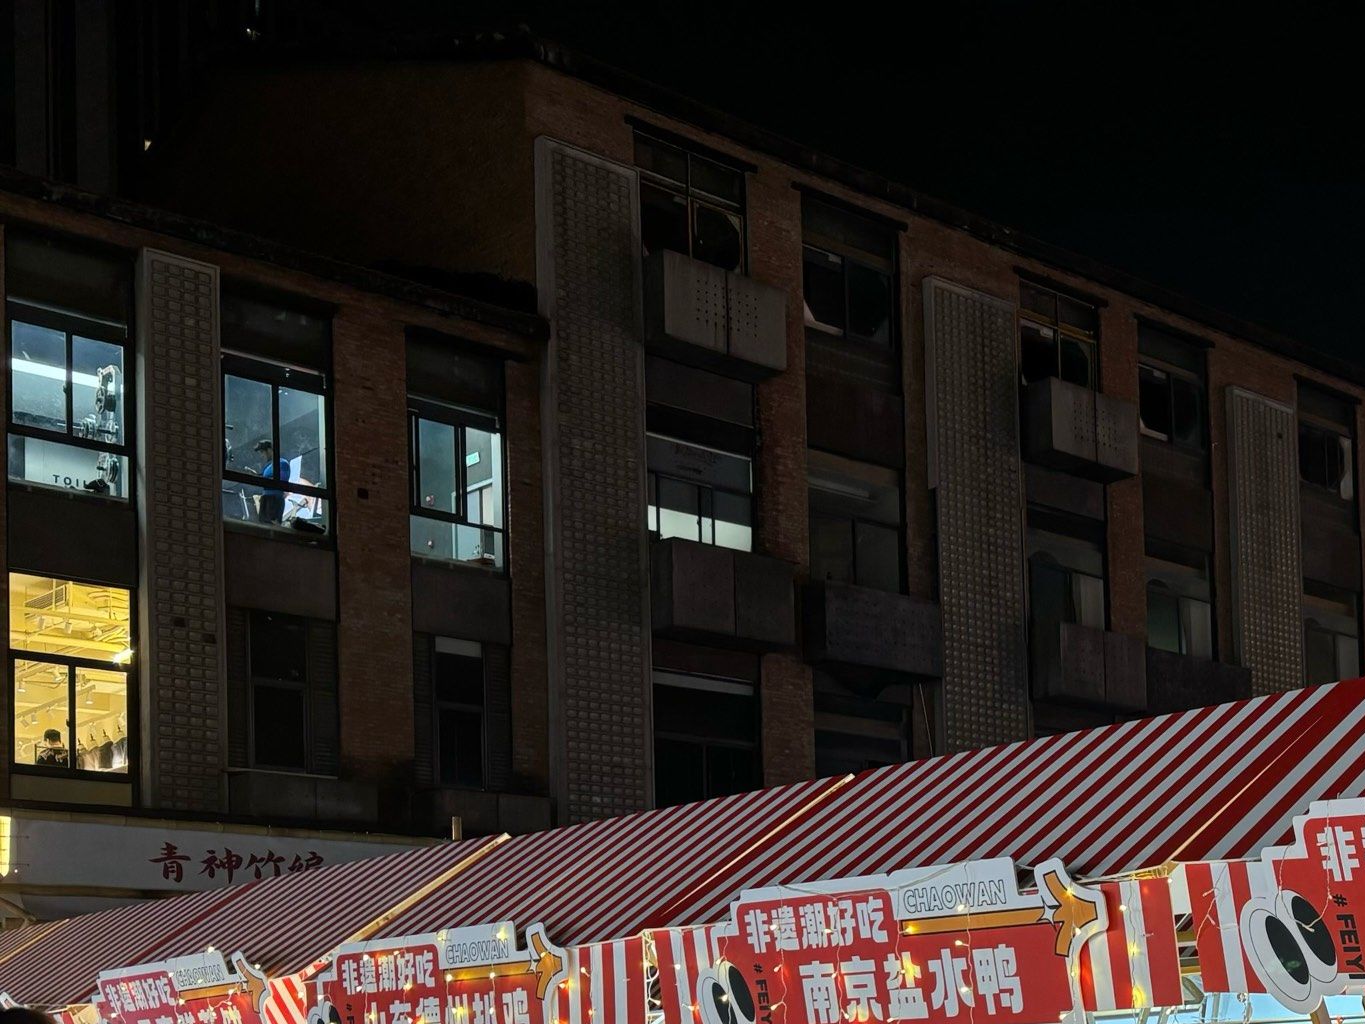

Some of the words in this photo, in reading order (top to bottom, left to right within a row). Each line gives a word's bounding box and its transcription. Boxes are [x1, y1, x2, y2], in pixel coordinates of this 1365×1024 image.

[903, 878, 1008, 915] CHAOWAN
[743, 899, 889, 955] 非遗潮好吃
[445, 938, 510, 965] CHAOWAN
[341, 950, 436, 996] 非遗潮好吃
